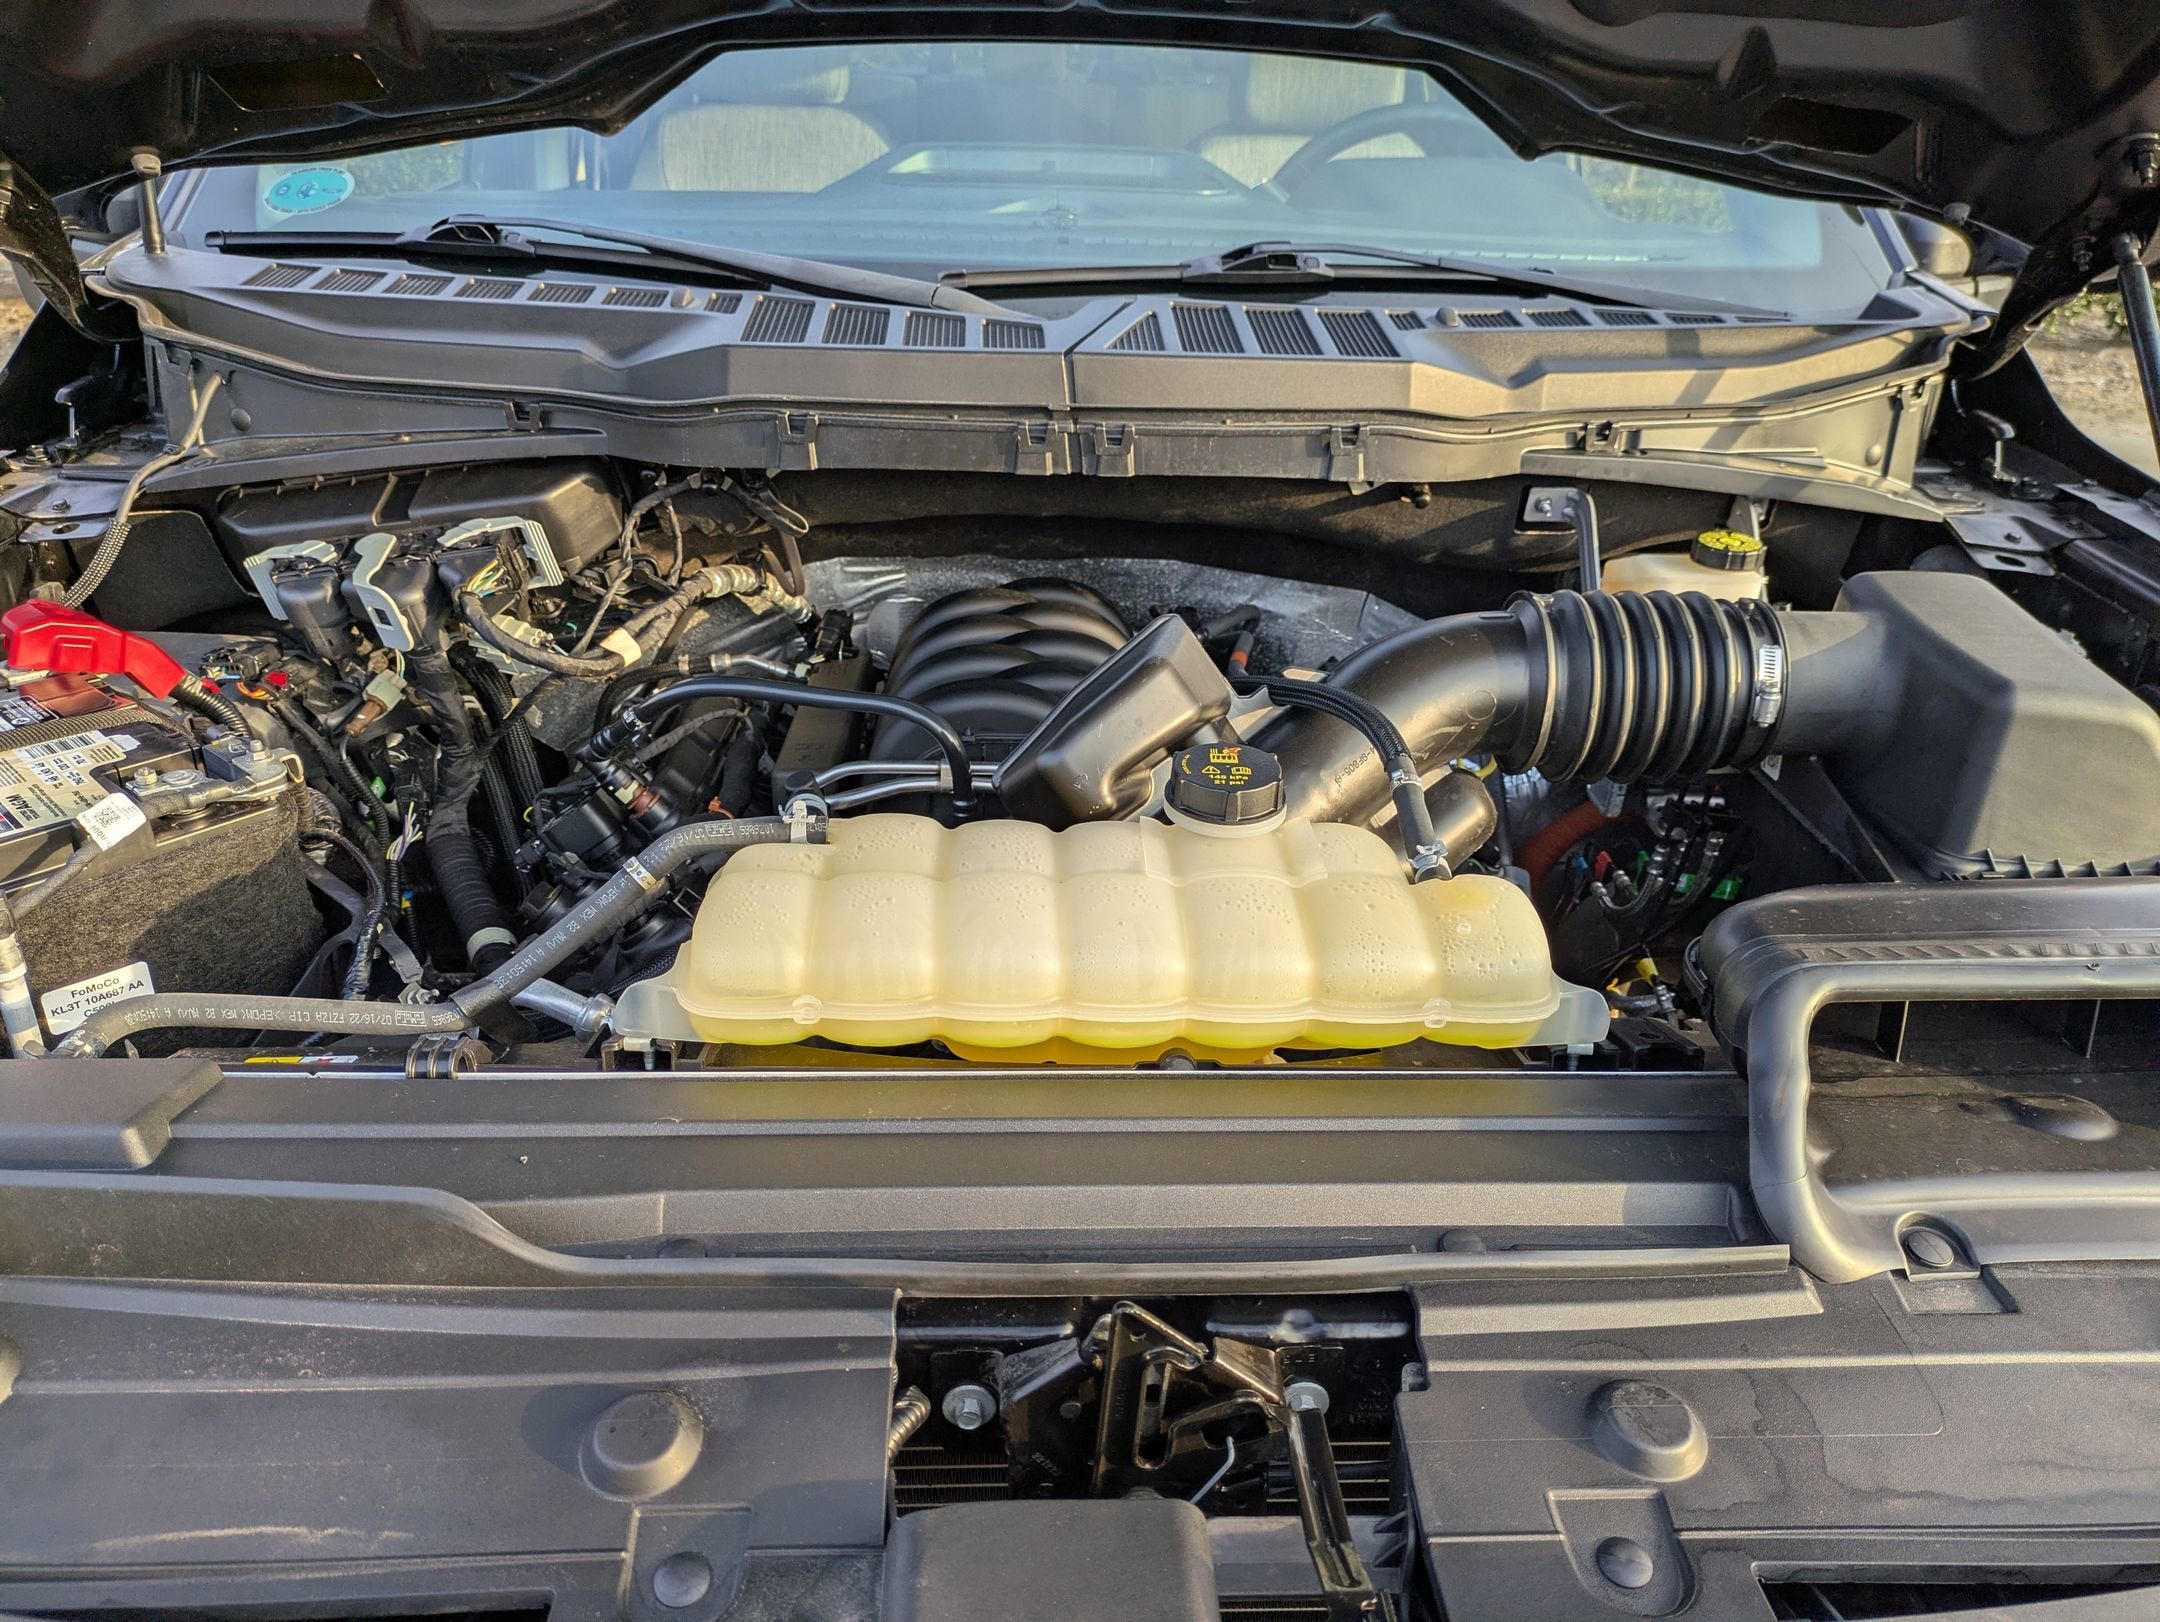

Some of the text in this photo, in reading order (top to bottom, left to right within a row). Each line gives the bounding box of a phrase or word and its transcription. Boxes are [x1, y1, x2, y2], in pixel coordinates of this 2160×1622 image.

[6, 793, 33, 810] AGM
[71, 977, 120, 998] FoMoCo
[50, 980, 145, 1017] KL3T 10A687 AA
[163, 1008, 171, 1018] A
[204, 1008, 216, 1018] B2
[288, 1011, 311, 1022] CIP
[348, 1013, 392, 1024] 07/16/22
